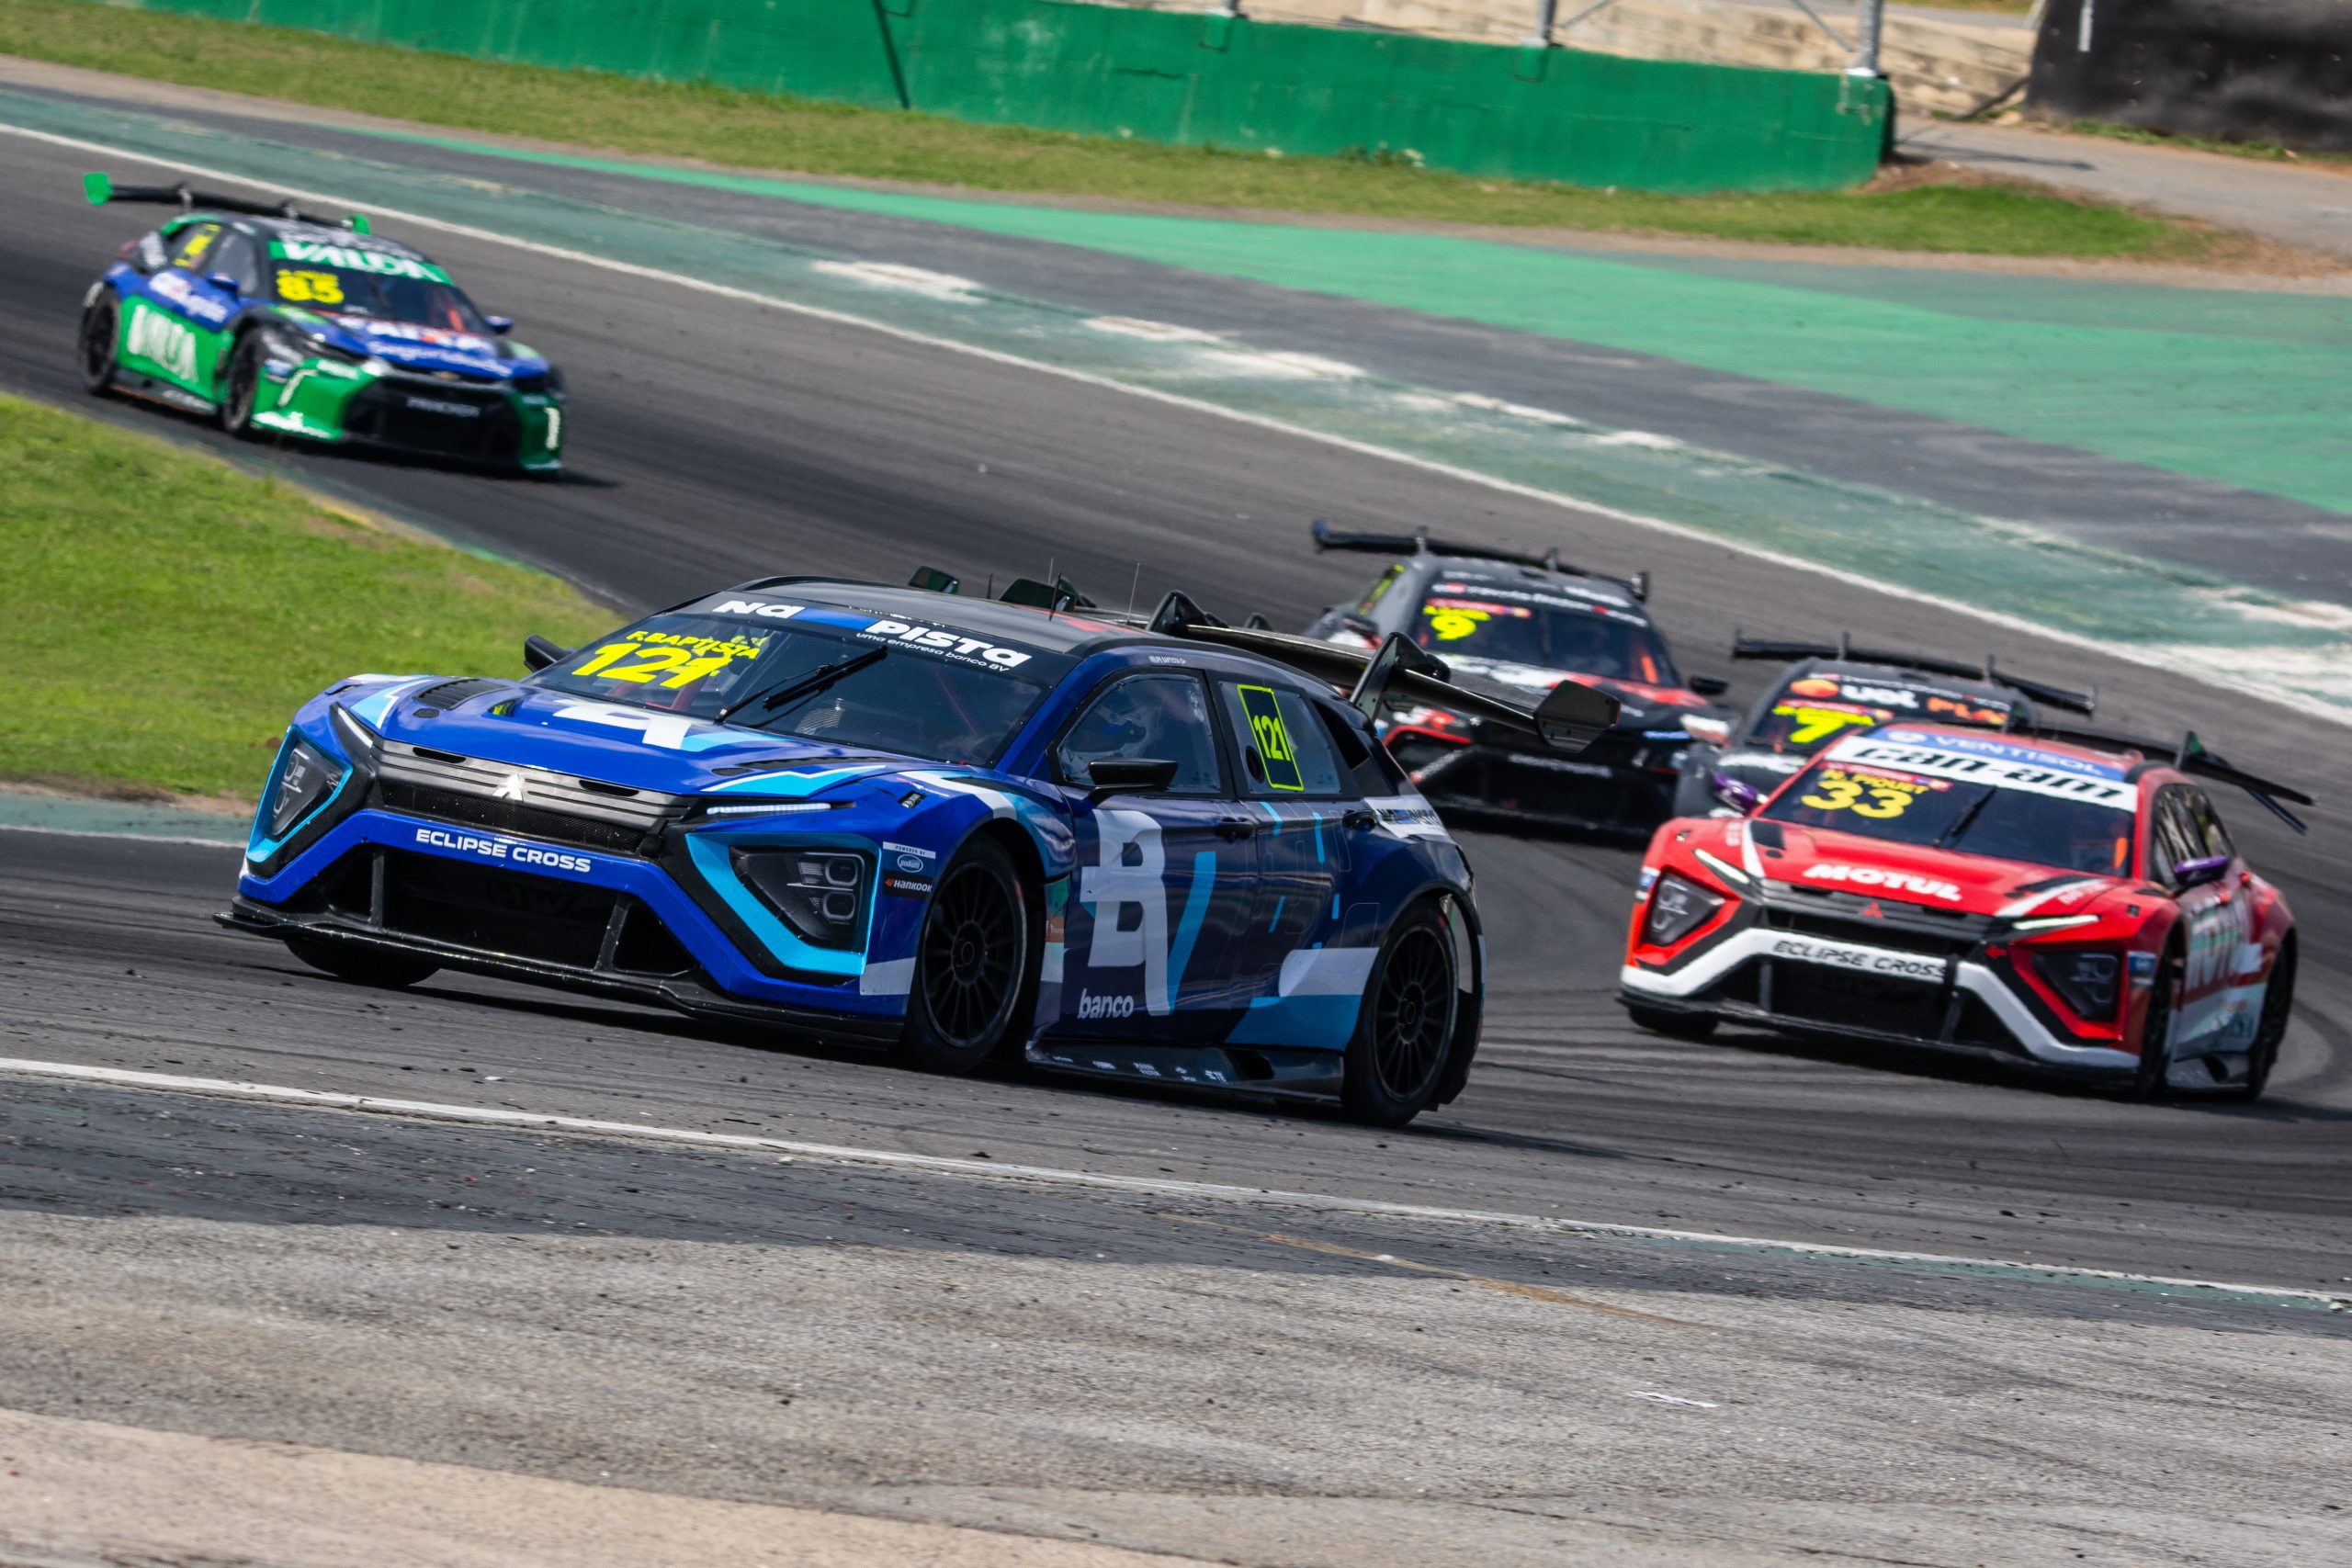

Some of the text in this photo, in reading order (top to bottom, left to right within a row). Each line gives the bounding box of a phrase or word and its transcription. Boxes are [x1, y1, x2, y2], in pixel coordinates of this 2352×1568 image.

[276, 276, 344, 304] 85
[1430, 615, 1476, 639] 9
[856, 632, 887, 643] uma
[888, 638, 945, 656] empresa
[945, 651, 988, 667] banco
[1253, 715, 1291, 761] 121
[1790, 709, 1845, 742] 7
[1854, 747, 2123, 798] can-am
[1934, 736, 2103, 775] VENTISOL
[1801, 781, 1914, 818] 33
[415, 829, 592, 873] ECLIPSE CROSS
[1802, 864, 1963, 902] MOTUL
[1772, 940, 1947, 979] ECLIPSE CROSS
[1077, 987, 1135, 1019] banco
